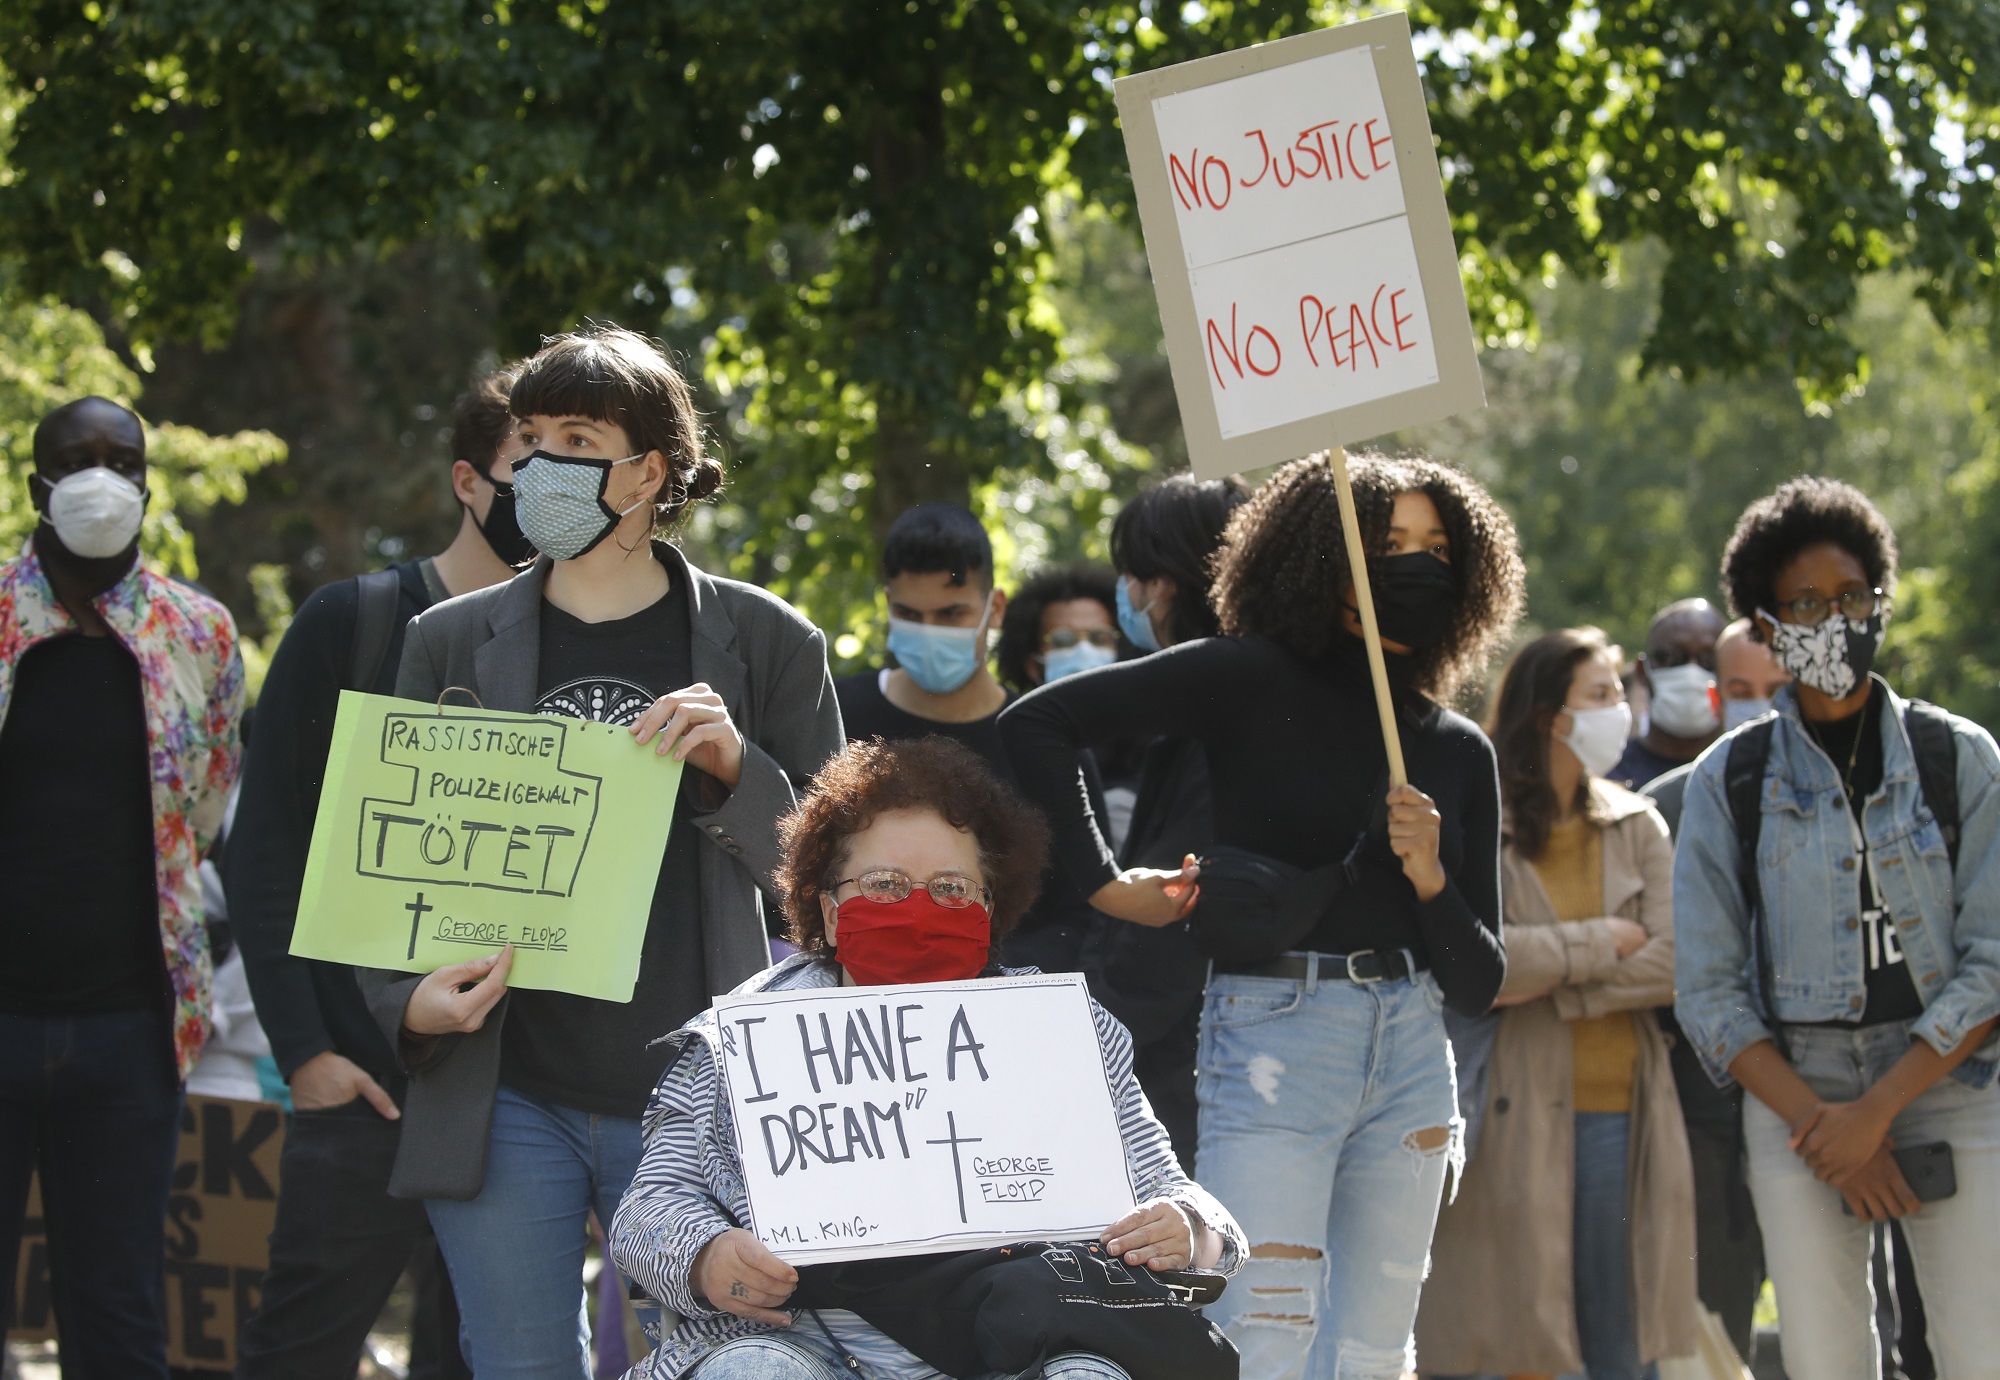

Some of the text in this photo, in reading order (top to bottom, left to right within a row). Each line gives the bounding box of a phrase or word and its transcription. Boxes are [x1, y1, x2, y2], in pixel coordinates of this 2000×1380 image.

[1169, 118, 1392, 211] NO JUSTICE
[1207, 283, 1418, 390] NO PEACE
[388, 720, 555, 758] RASSISTISCHE
[429, 771, 590, 807] POLIZEIGEWALT
[371, 812, 576, 890] TÖTET
[437, 915, 567, 951] GEORGE FLOYD
[795, 1004, 929, 1094] HAVE
[946, 1003, 990, 1082] A
[973, 1156, 1054, 1176] GEORGE
[980, 1178, 1046, 1201] FLOYD
